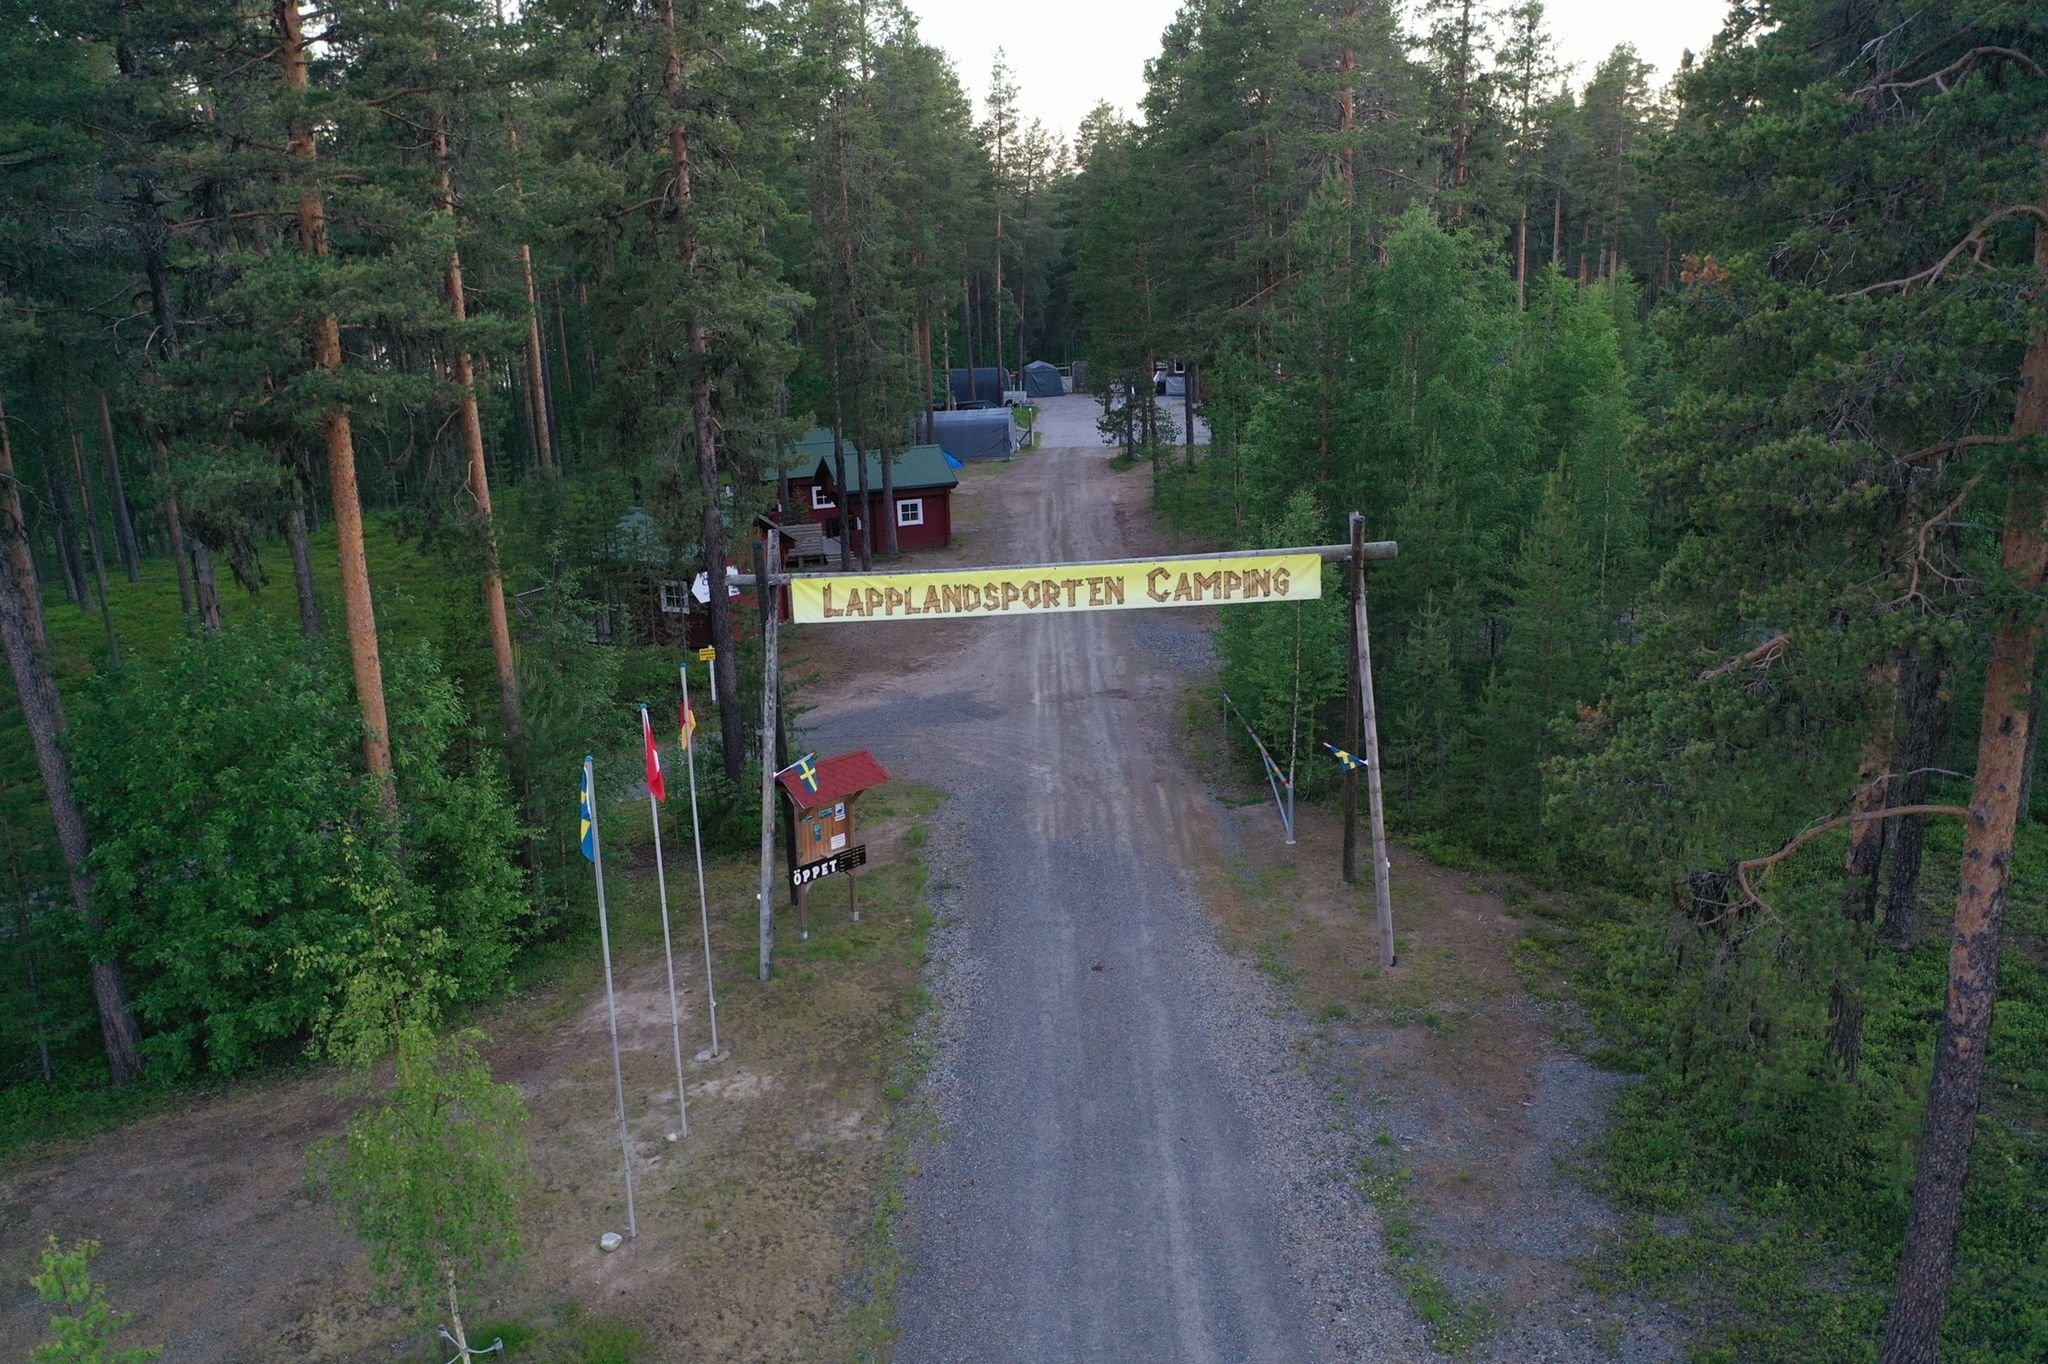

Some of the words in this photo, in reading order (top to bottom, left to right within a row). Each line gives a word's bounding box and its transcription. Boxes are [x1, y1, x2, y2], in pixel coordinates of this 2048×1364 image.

[823, 576, 1125, 618] LAPPLANDSPORTEN
[1147, 567, 1291, 602] CAMPING
[794, 860, 837, 886] ÖPPET
